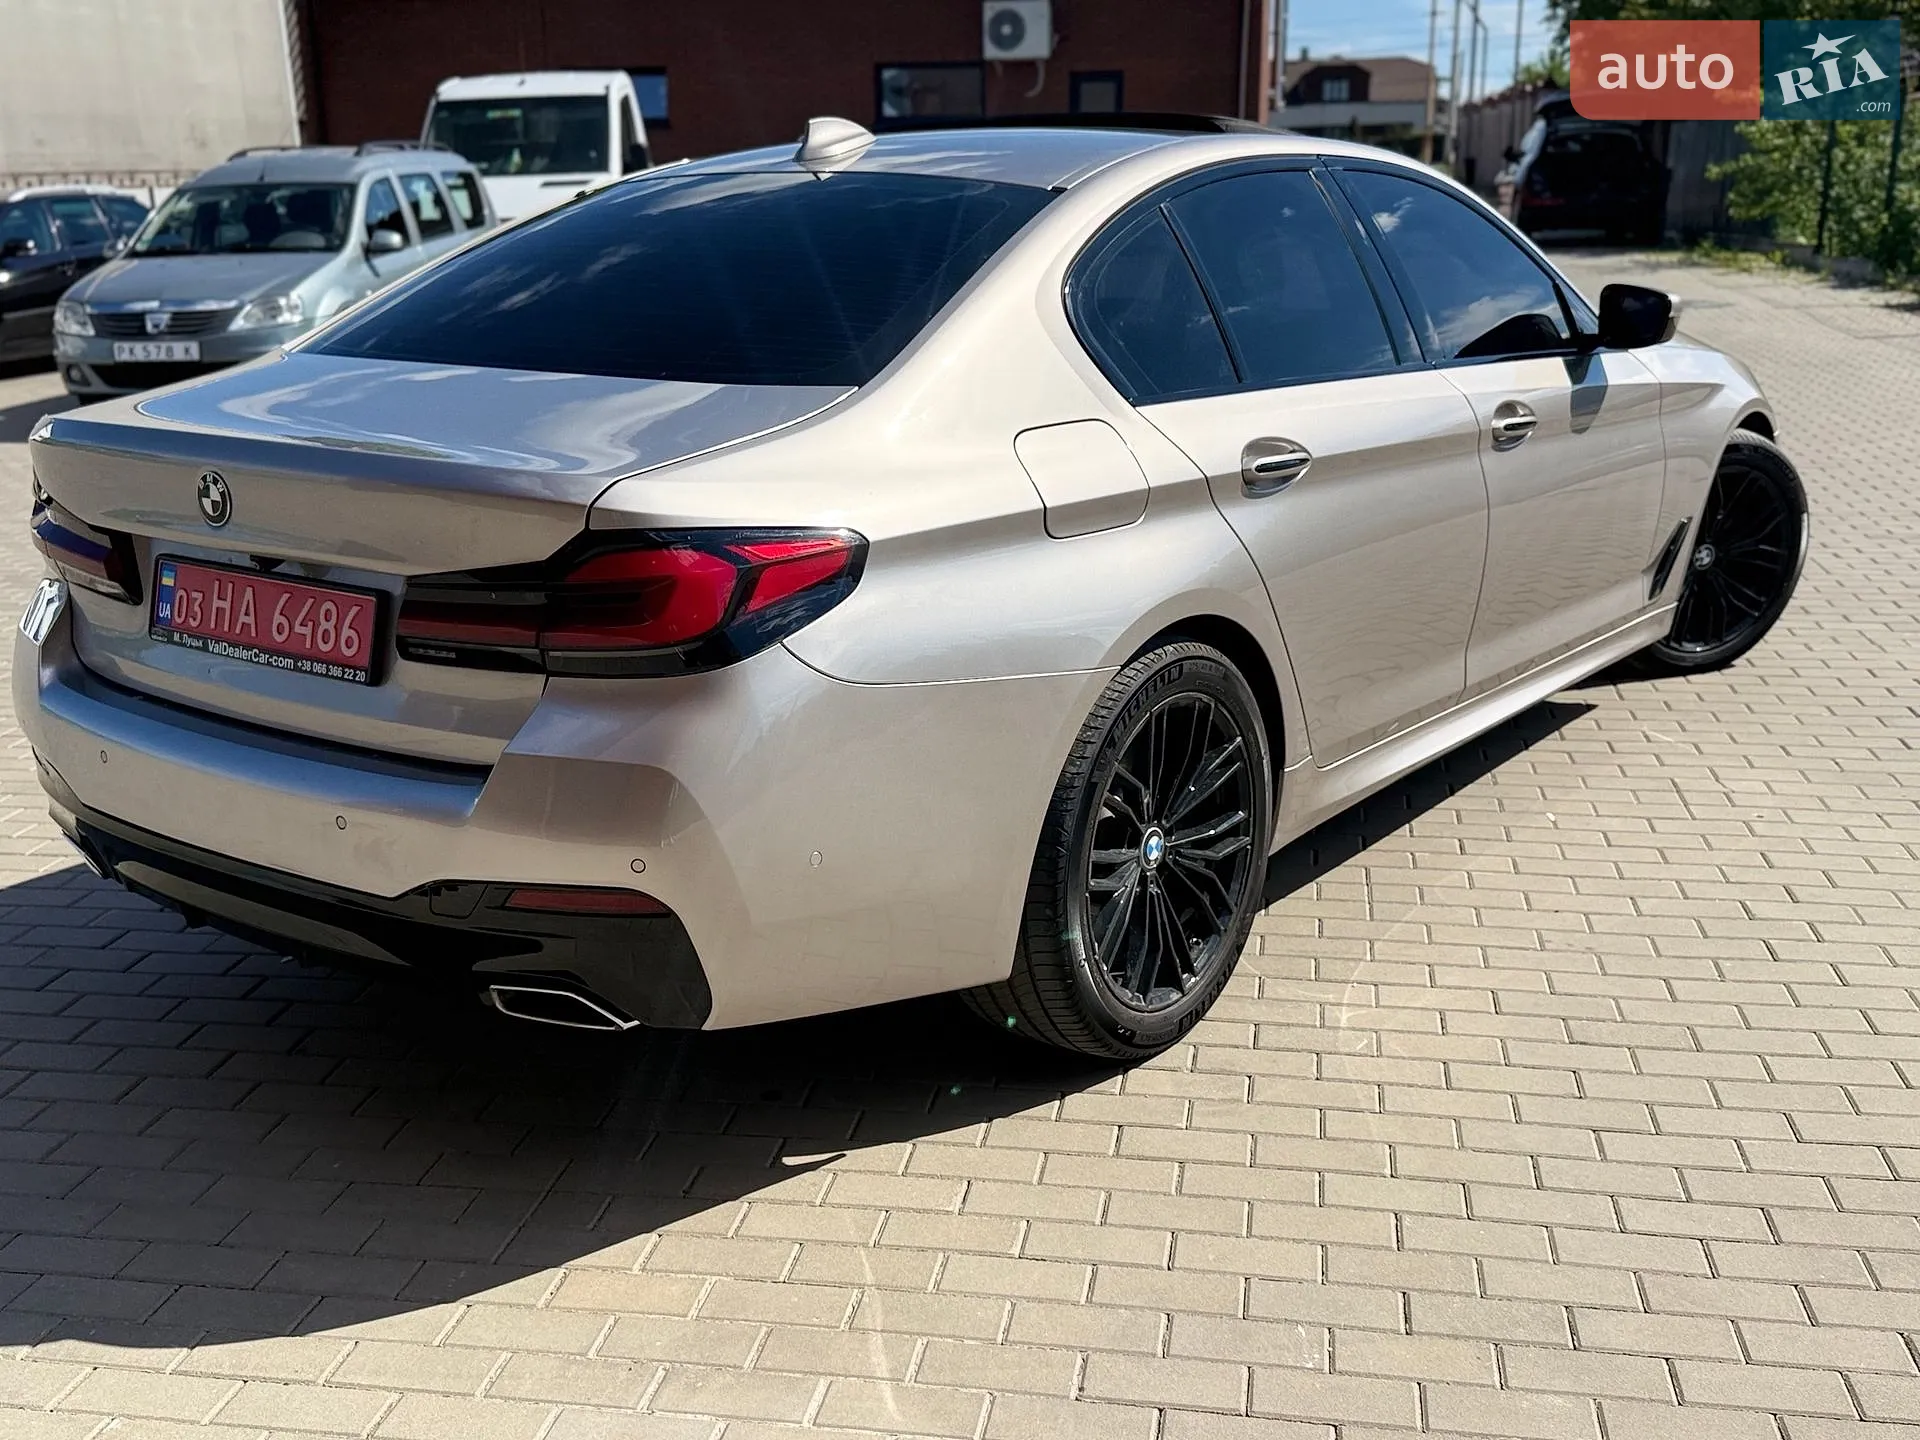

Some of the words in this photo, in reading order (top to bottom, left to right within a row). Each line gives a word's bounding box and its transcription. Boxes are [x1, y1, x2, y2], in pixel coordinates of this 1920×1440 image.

[159, 603, 171, 619] UA
[174, 588, 205, 628] 03
[210, 579, 258, 638] HA
[272, 592, 363, 657] 6486
[207, 639, 294, 669] ValDealerCar-com
[297, 659, 311, 671] +38
[312, 663, 327, 674] 066
[328, 666, 343, 677] 366
[344, 668, 354, 680] 22
[355, 671, 366, 682] 20
[1113, 664, 1182, 745] MICHELIN
